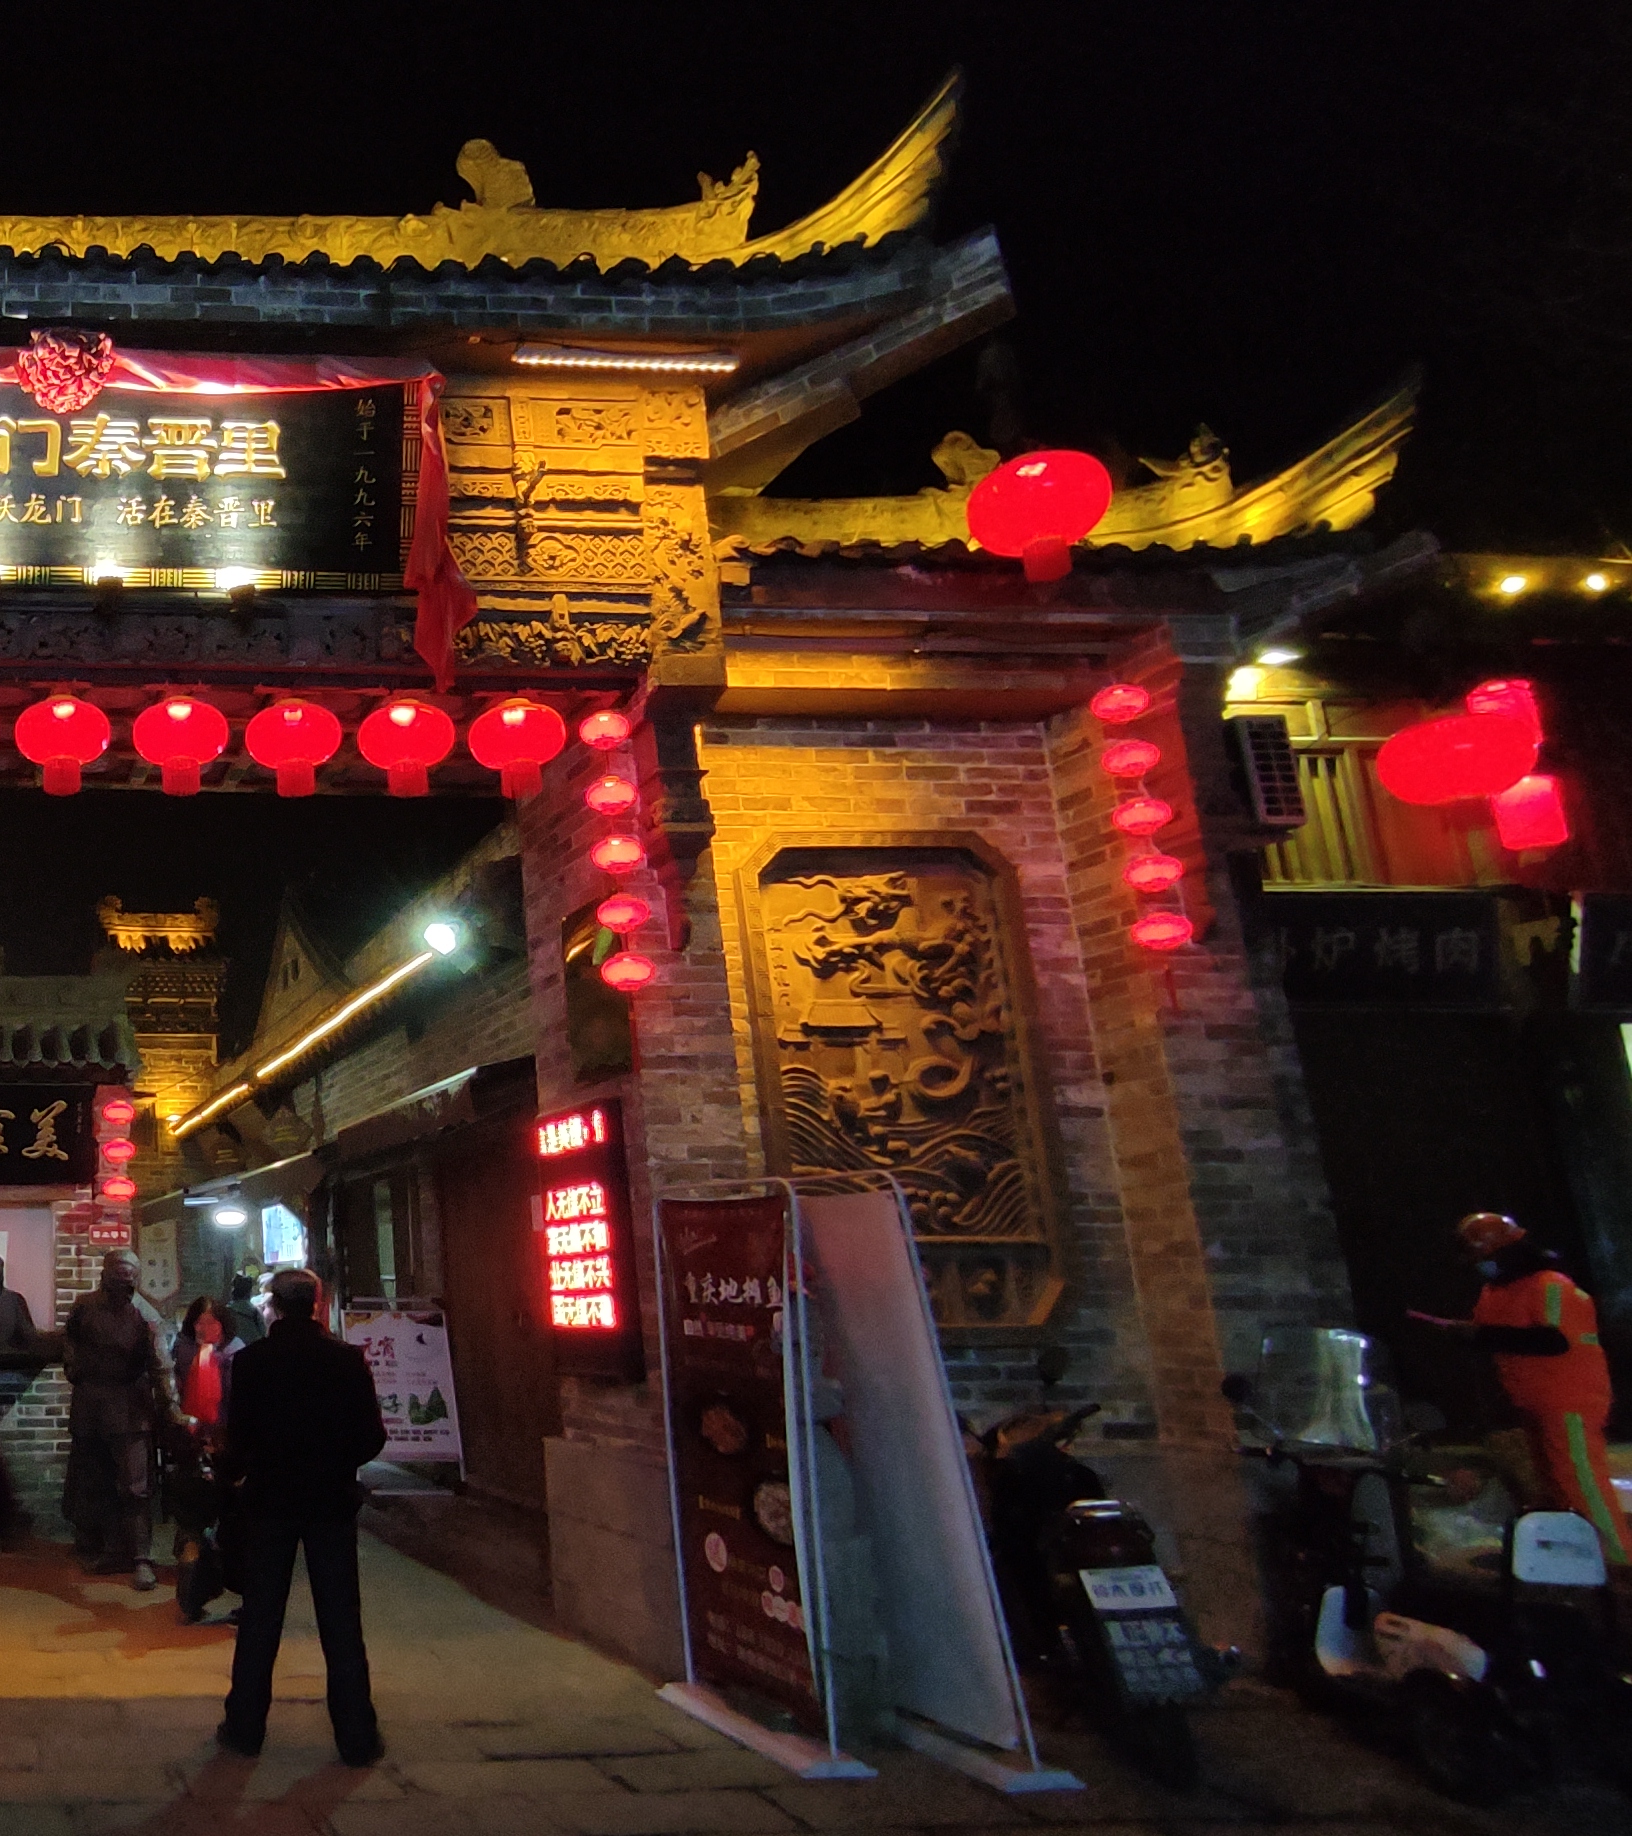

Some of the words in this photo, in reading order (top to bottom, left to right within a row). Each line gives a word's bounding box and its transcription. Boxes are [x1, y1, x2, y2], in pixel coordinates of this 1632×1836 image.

[352, 398, 377, 552] 始于一九九六年
[115, 494, 278, 529] 活在秦晋里
[546, 1183, 605, 1220] 人无信不立
[550, 1255, 613, 1291] 业无信不兴
